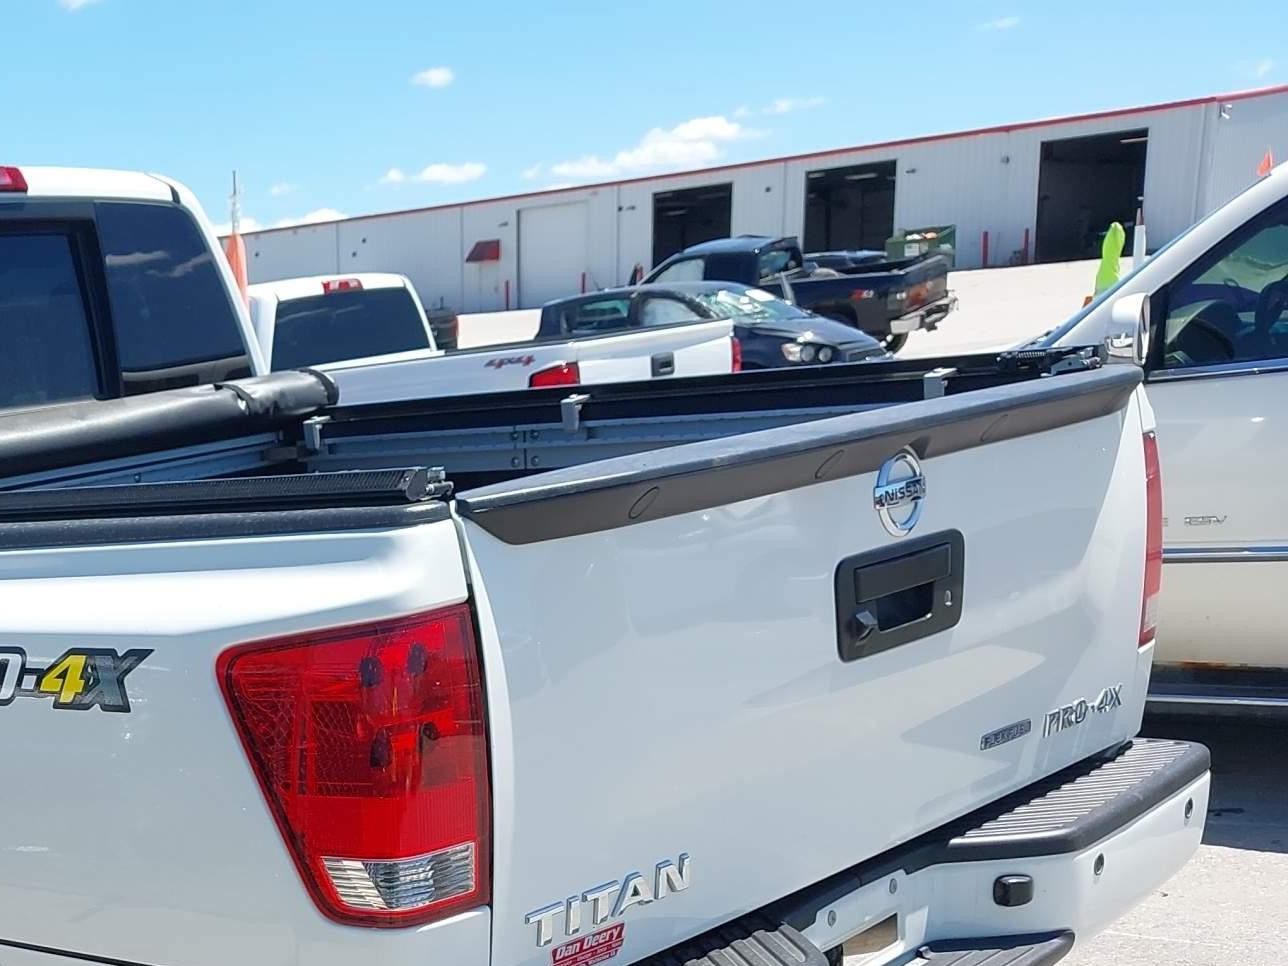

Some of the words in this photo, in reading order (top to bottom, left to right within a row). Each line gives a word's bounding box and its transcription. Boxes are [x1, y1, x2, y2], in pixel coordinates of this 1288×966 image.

[1043, 682, 1123, 738] PRO-4X
[525, 853, 690, 947] TITAN
[555, 941, 581, 960] Dan
[583, 926, 621, 950] Deery
